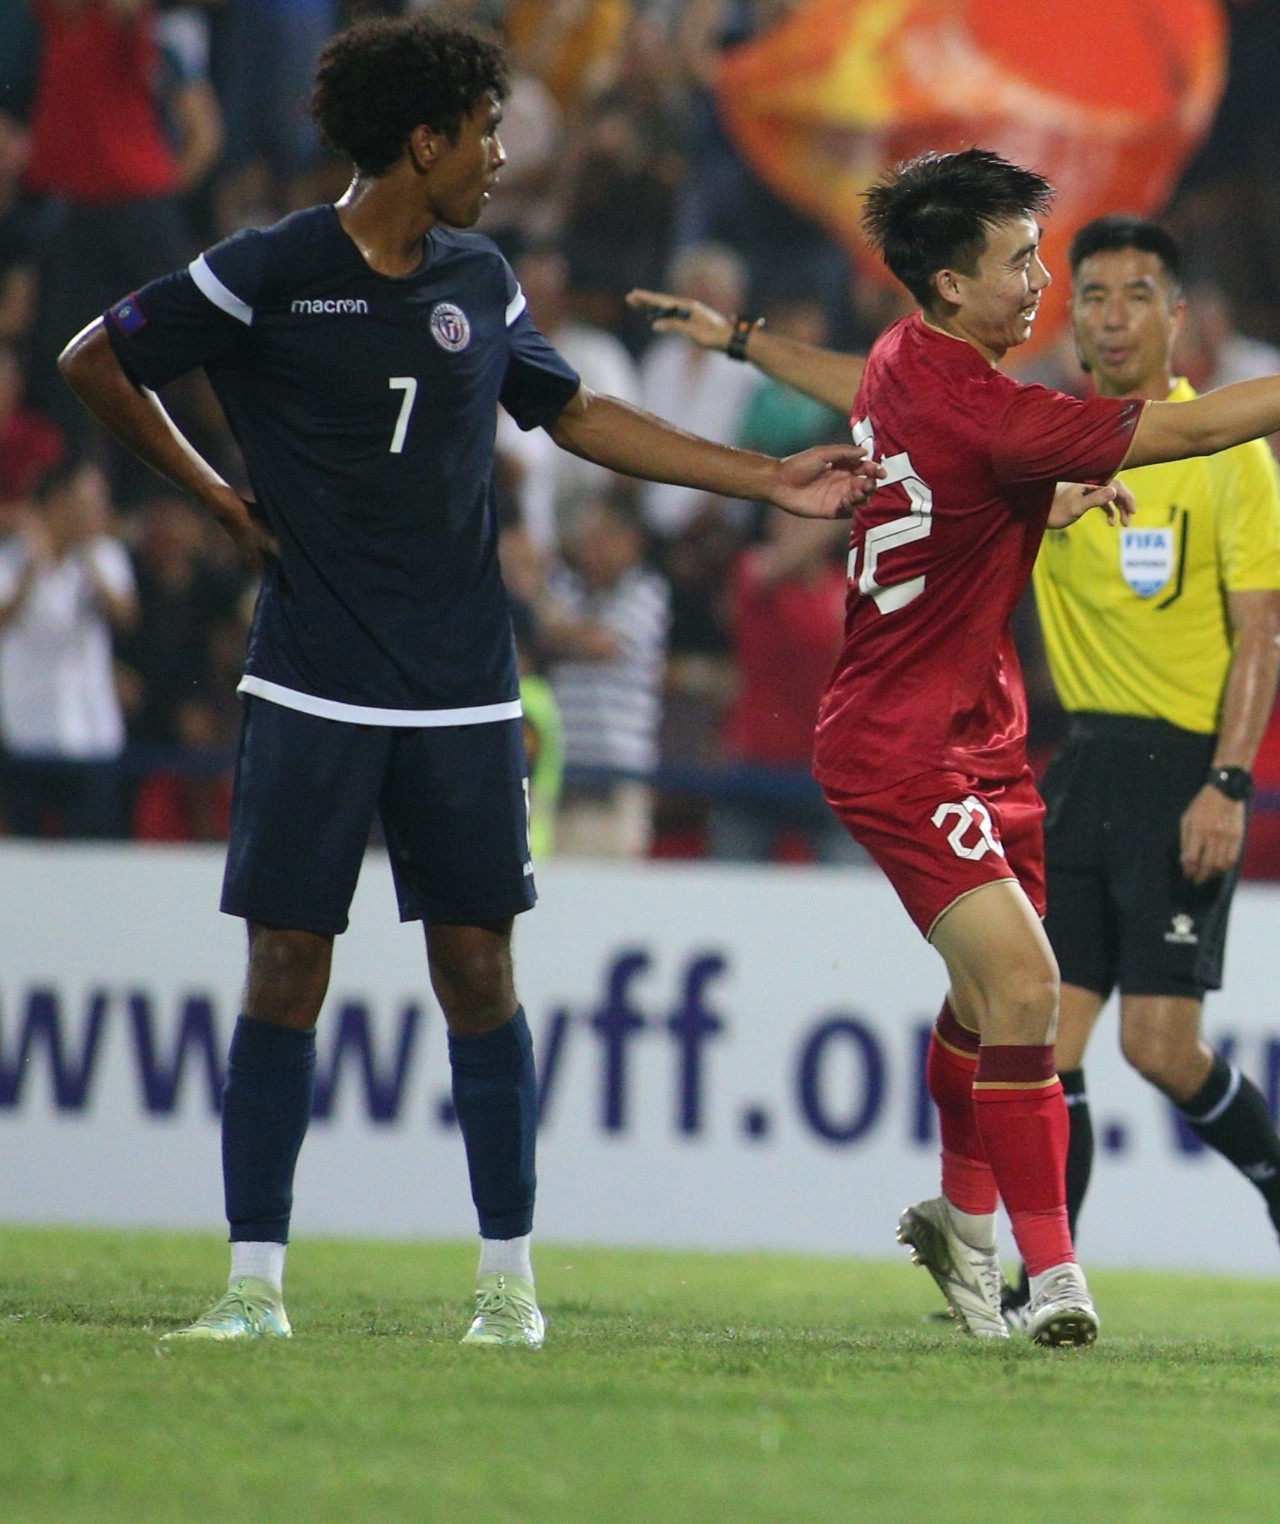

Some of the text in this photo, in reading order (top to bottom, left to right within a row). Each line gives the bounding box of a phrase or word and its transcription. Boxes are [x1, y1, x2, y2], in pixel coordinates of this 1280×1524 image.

[291, 299, 369, 314] macron
[388, 376, 418, 454] 7
[1125, 533, 1166, 548] FIFA
